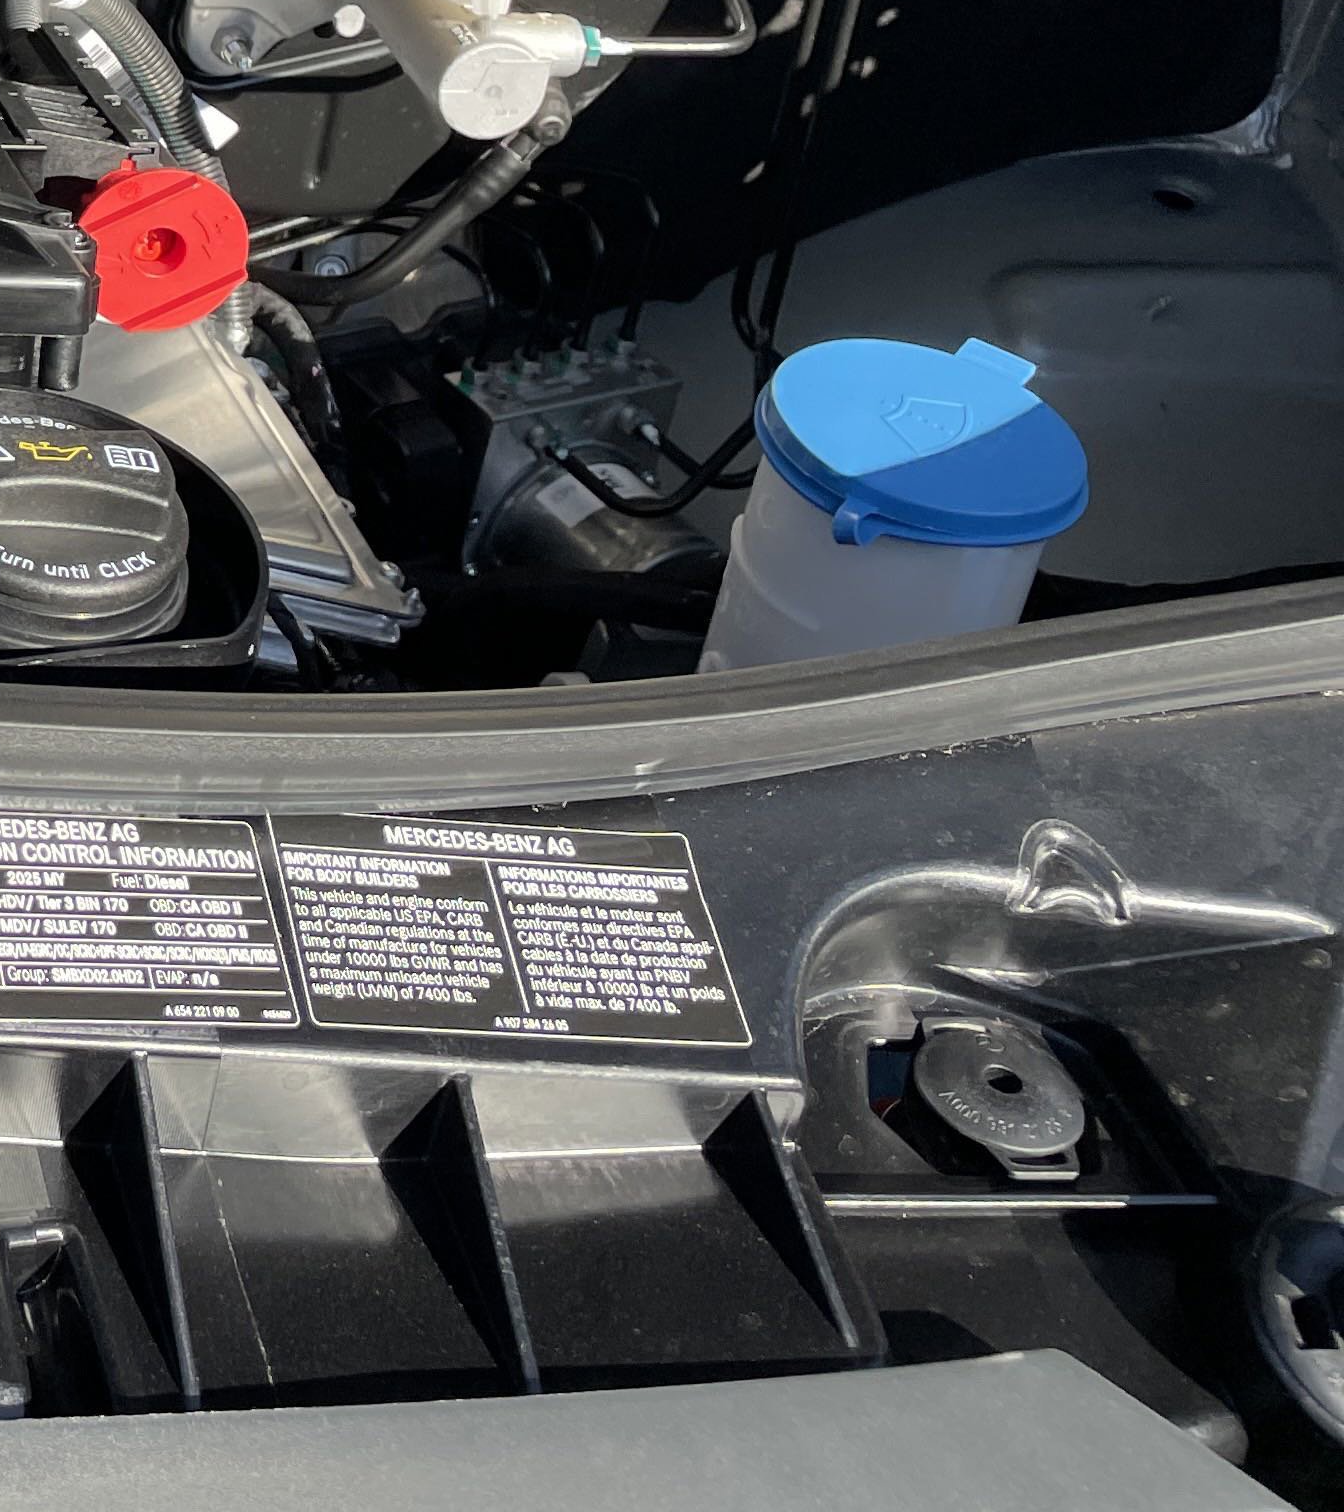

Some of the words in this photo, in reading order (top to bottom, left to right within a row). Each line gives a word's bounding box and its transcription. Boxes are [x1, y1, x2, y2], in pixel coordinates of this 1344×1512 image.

[44, 563, 90, 580] until
[98, 550, 156, 578] CLICK
[110, 822, 140, 843] AG
[384, 826, 543, 854] MERCEDES-BENZ
[547, 836, 576, 857] AG
[22, 842, 117, 865] CONTROL
[120, 846, 254, 869] INFORMATION
[283, 851, 357, 869] IMPORTANT
[360, 857, 450, 876] INFORMATION
[6, 870, 42, 886] 2025
[43, 871, 65, 887] MY
[111, 872, 144, 889] Fuel:
[144, 873, 189, 890] Diesel
[286, 866, 315, 881] FOR
[315, 868, 352, 884] BODY
[354, 871, 419, 888] BUILDERS
[498, 866, 596, 885] INFORMATIONS
[598, 872, 688, 890] IMPORTANTES
[290, 886, 318, 902] This
[319, 889, 364, 905] vehicle
[365, 893, 391, 907] and
[391, 894, 434, 911] engine
[435, 897, 489, 912] conform
[502, 881, 541, 896] POUR
[541, 883, 567, 898] LES
[568, 885, 658, 903] CARROSSIERS
[35, 894, 62, 910] Tier
[63, 895, 75, 911] 3
[75, 896, 101, 911] BIN
[103, 897, 129, 912] 170
[178, 899, 201, 914] CA
[201, 900, 231, 915] OBD
[232, 900, 243, 916] II
[294, 902, 310, 916] to
[311, 903, 327, 917] all
[329, 906, 392, 922] applicable
[393, 908, 414, 923] US
[413, 909, 446, 926] EPA,
[446, 911, 484, 927] CARB
[507, 900, 526, 915] Le
[526, 902, 579, 918] véhicule
[579, 905, 595, 919] et
[594, 905, 609, 920] le
[609, 908, 654, 922] moteur
[656, 910, 686, 924] sont
[0, 918, 40, 936] MDV/
[43, 919, 87, 935] SULEV
[90, 920, 117, 936] 170
[184, 922, 207, 938] CA
[206, 923, 237, 939] OBD
[237, 924, 249, 939] II
[298, 919, 323, 933] and
[324, 919, 384, 936] Canadian
[385, 925, 455, 941] regulations
[457, 928, 472, 942] at
[472, 928, 495, 943] the
[513, 917, 580, 933] conformes
[581, 922, 606, 935] aux
[606, 921, 666, 938] directives
[301, 933, 331, 949] time
[332, 935, 346, 949] of
[348, 938, 428, 954] manufacture
[429, 940, 447, 955] for
[450, 943, 503, 959] vehicles
[517, 930, 554, 946] CARB
[596, 936, 612, 950] et
[612, 936, 630, 951] du
[630, 937, 679, 953] Canada
[680, 941, 714, 957] appli-
[305, 950, 341, 965] under
[346, 951, 387, 967] 10000
[389, 954, 410, 969] lbs
[410, 955, 451, 970] GVWR
[453, 958, 479, 972] and
[479, 959, 504, 974] has
[7, 966, 49, 985] Group:
[155, 969, 190, 985] EVAP:
[191, 971, 220, 987] n/a
[309, 966, 319, 979] a
[319, 967, 382, 982] maximum
[384, 970, 444, 986] unloaded
[444, 973, 490, 989] vehicle
[311, 981, 356, 999] weight
[357, 983, 399, 1001] (UVW)
[400, 985, 414, 1000] of
[415, 986, 451, 1002] 7400
[452, 988, 477, 1003] lbs.
